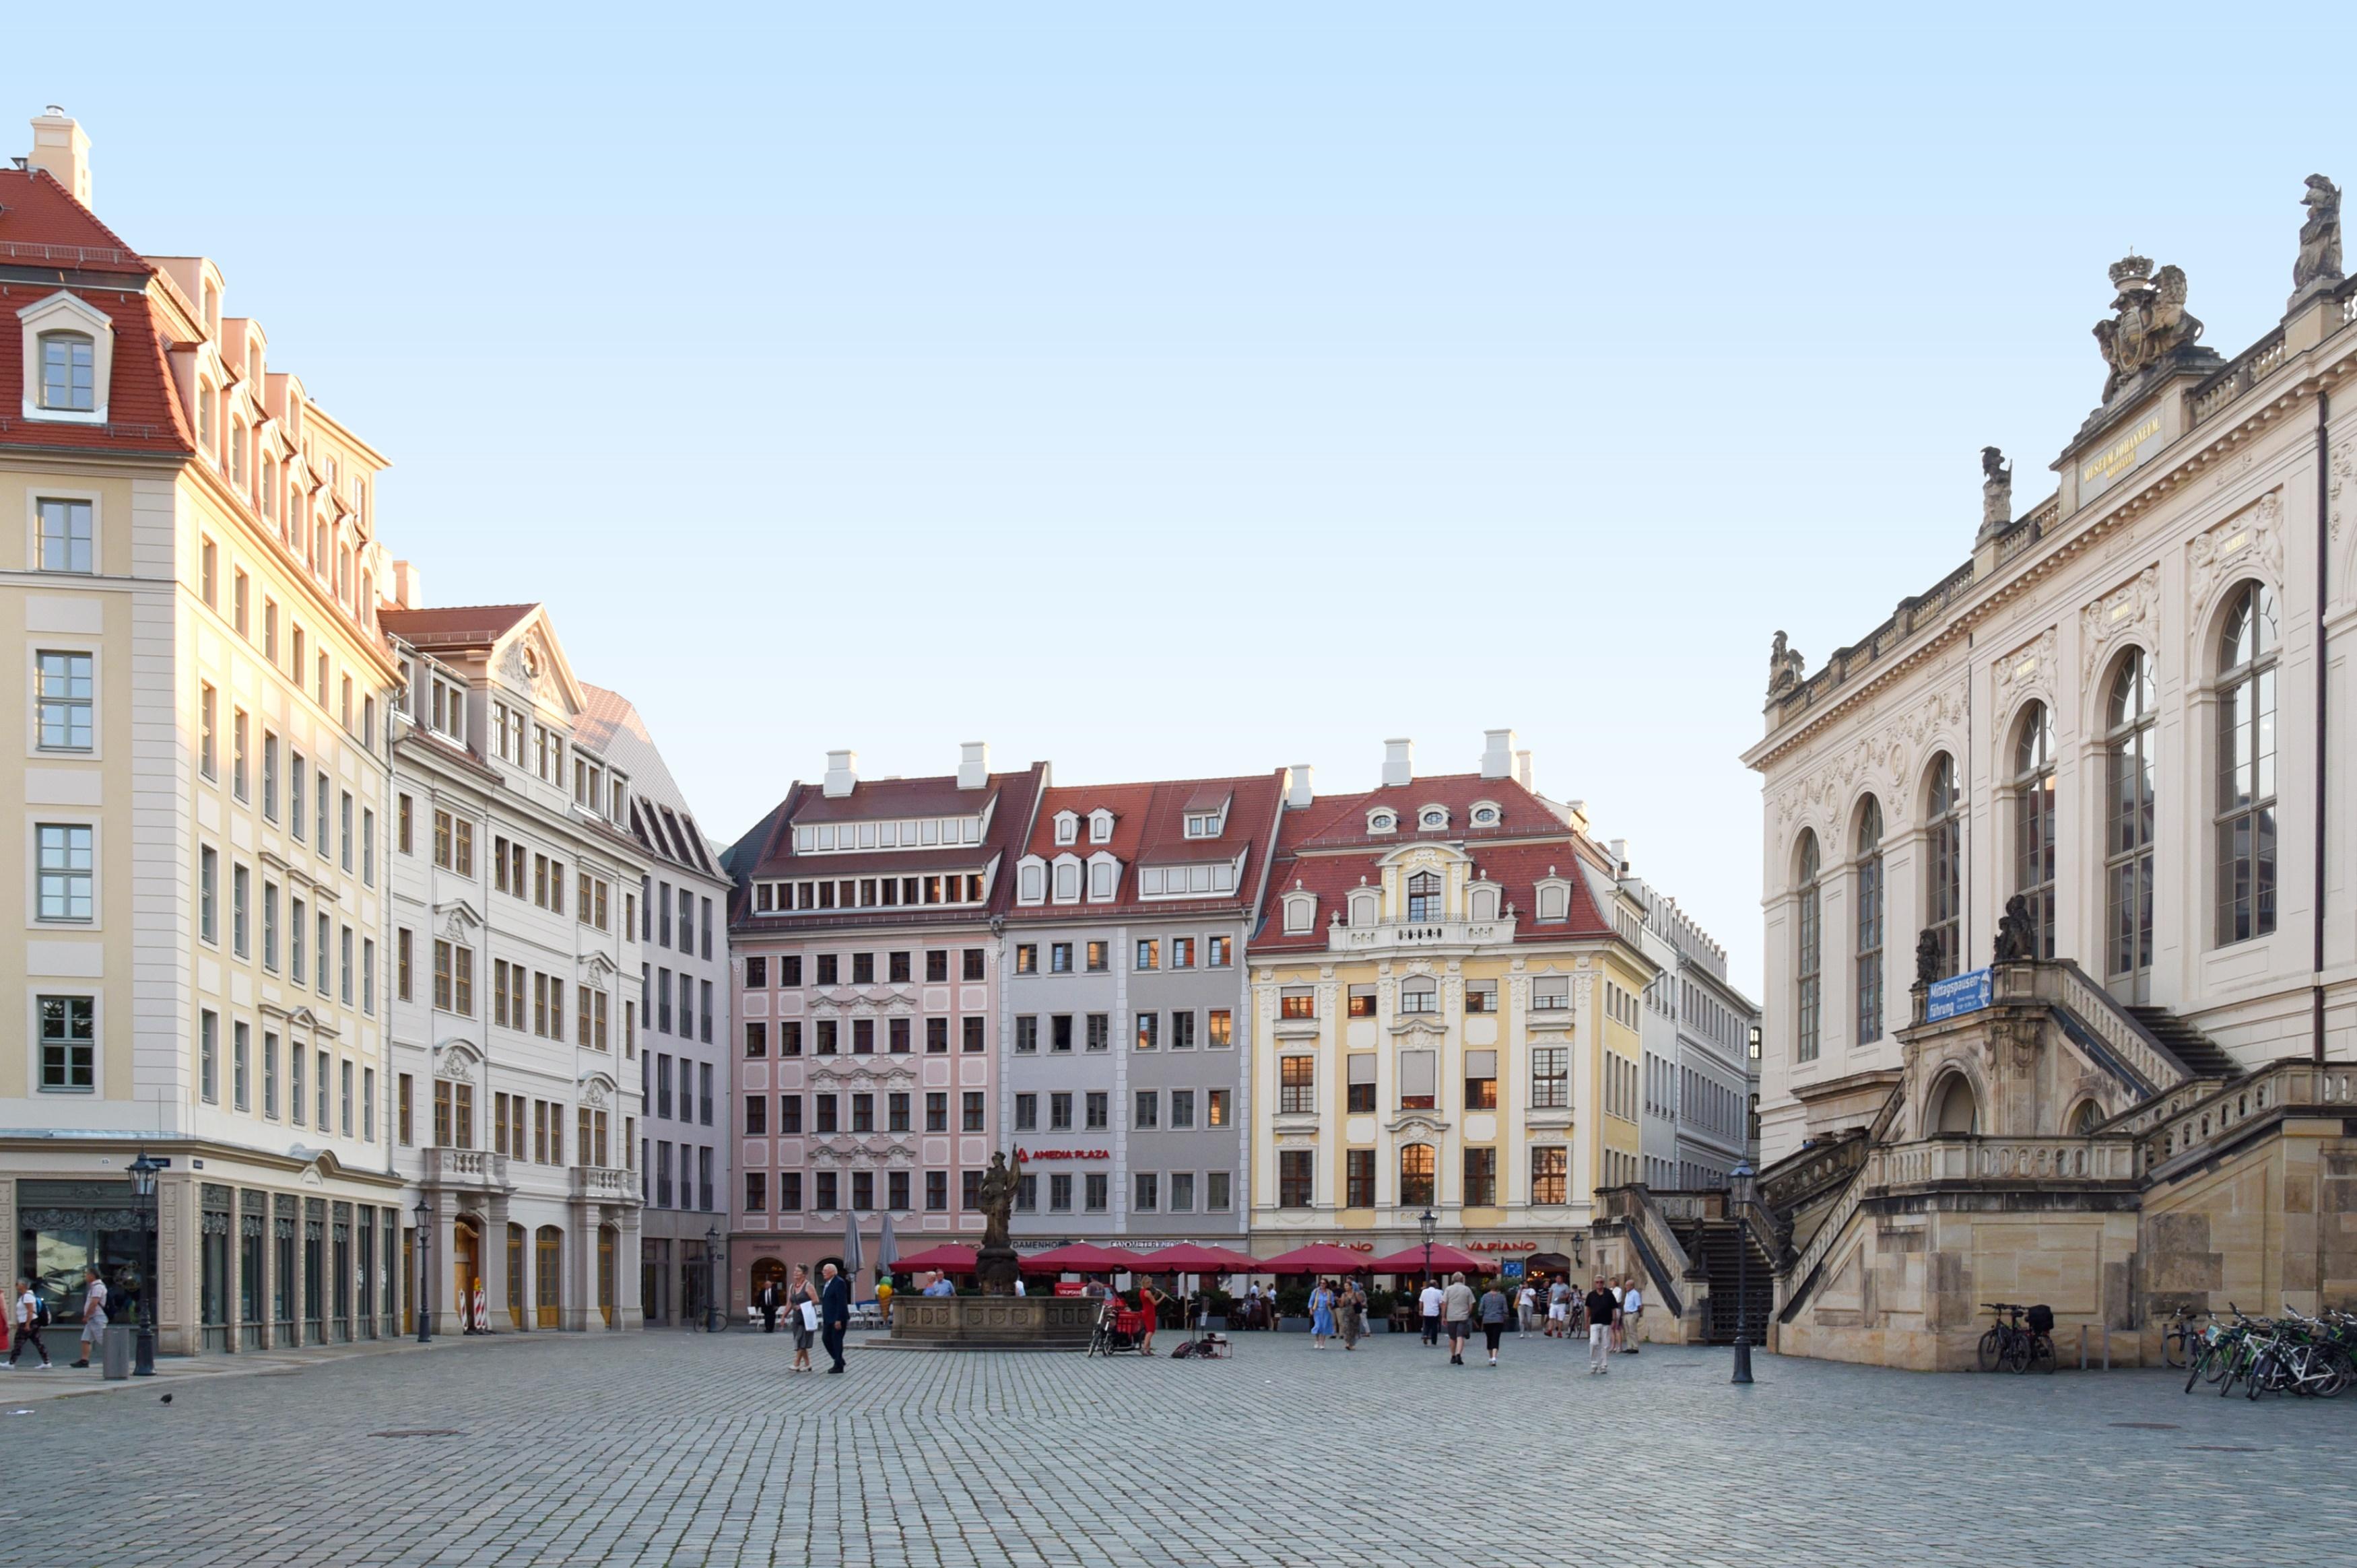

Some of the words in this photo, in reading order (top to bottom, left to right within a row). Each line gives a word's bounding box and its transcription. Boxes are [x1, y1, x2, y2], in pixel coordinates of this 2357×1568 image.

[1931, 976, 1980, 999] Mittagspausen-
[1033, 1150, 1072, 1159] AMEDIA
[1075, 1149, 1110, 1159] PLAZA
